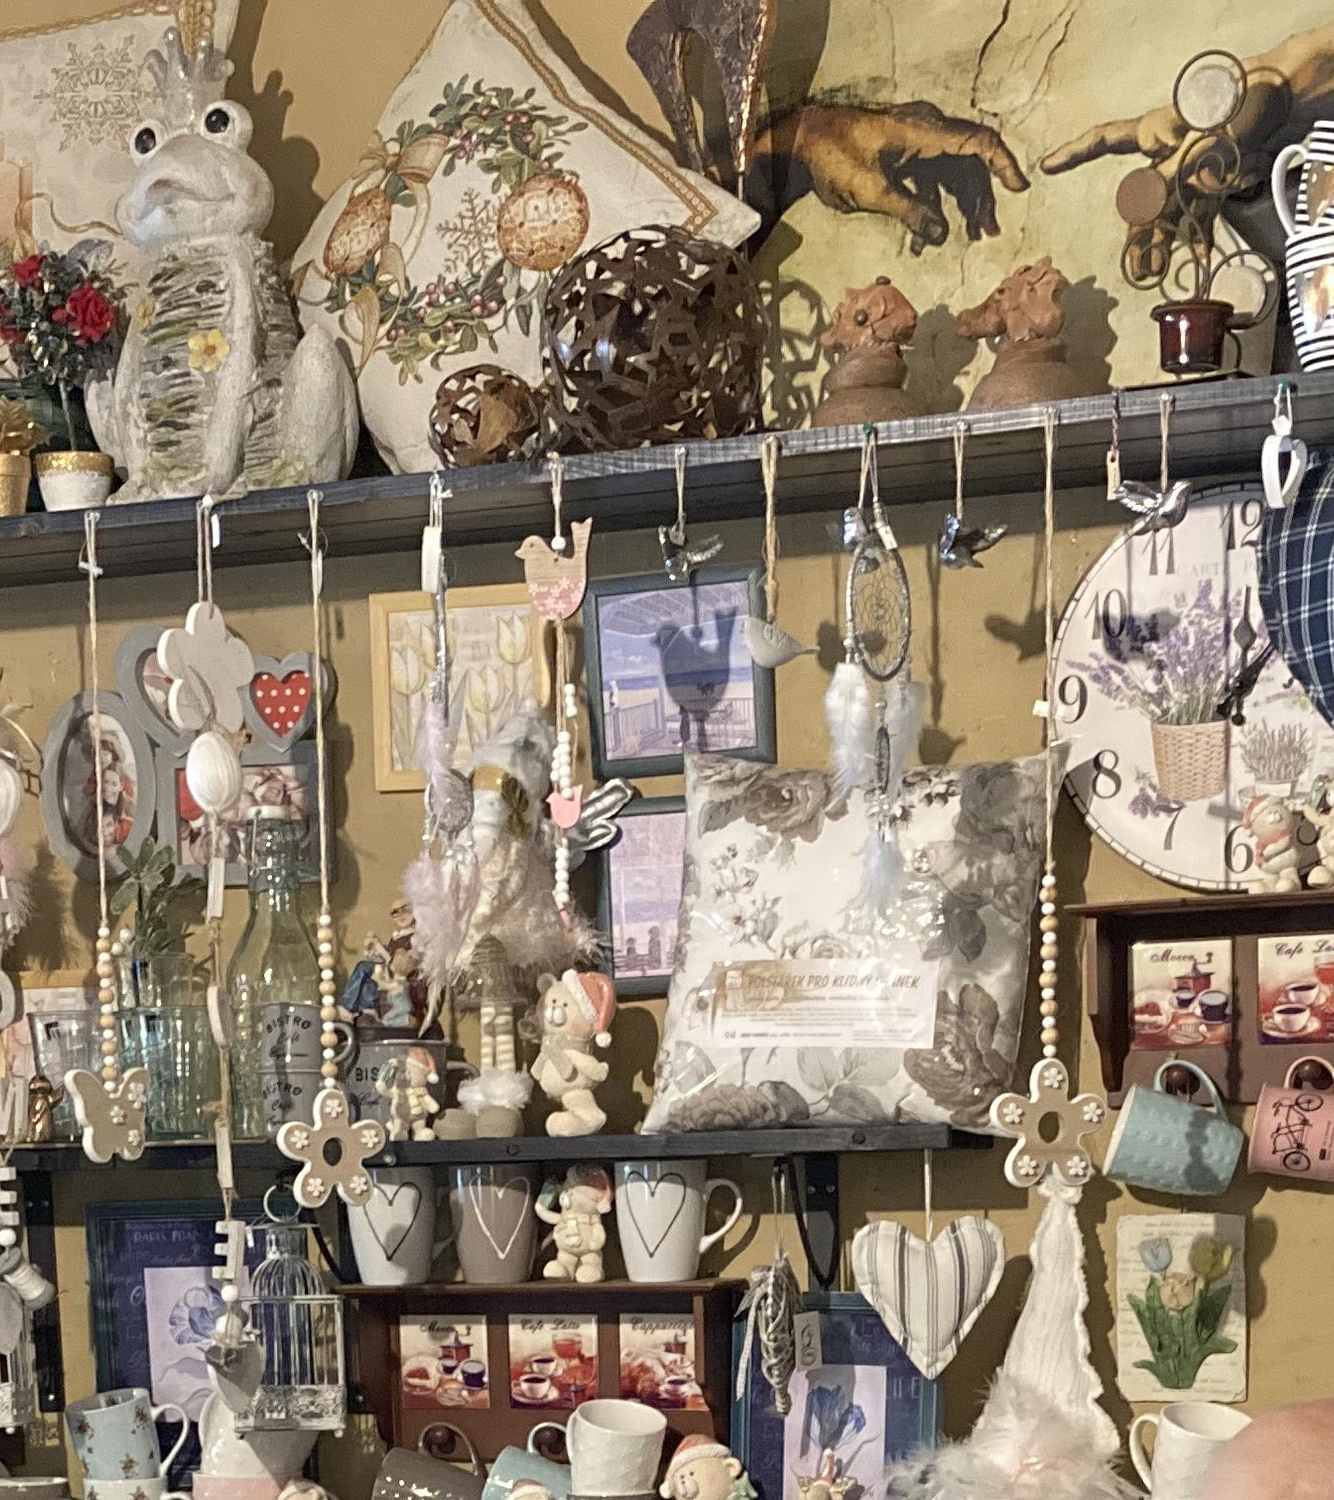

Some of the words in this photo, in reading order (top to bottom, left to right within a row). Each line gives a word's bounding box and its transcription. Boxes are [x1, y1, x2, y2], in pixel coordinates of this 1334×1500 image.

[1220, 499, 1263, 550] 12
[1083, 588, 1128, 641] 10
[1058, 674, 1089, 724] 9
[1090, 748, 1123, 800] 8
[1223, 823, 1255, 874] 6
[1150, 947, 1195, 963] Mocca
[807, 974, 830, 989] PRO
[266, 1014, 312, 1034] BISTRO
